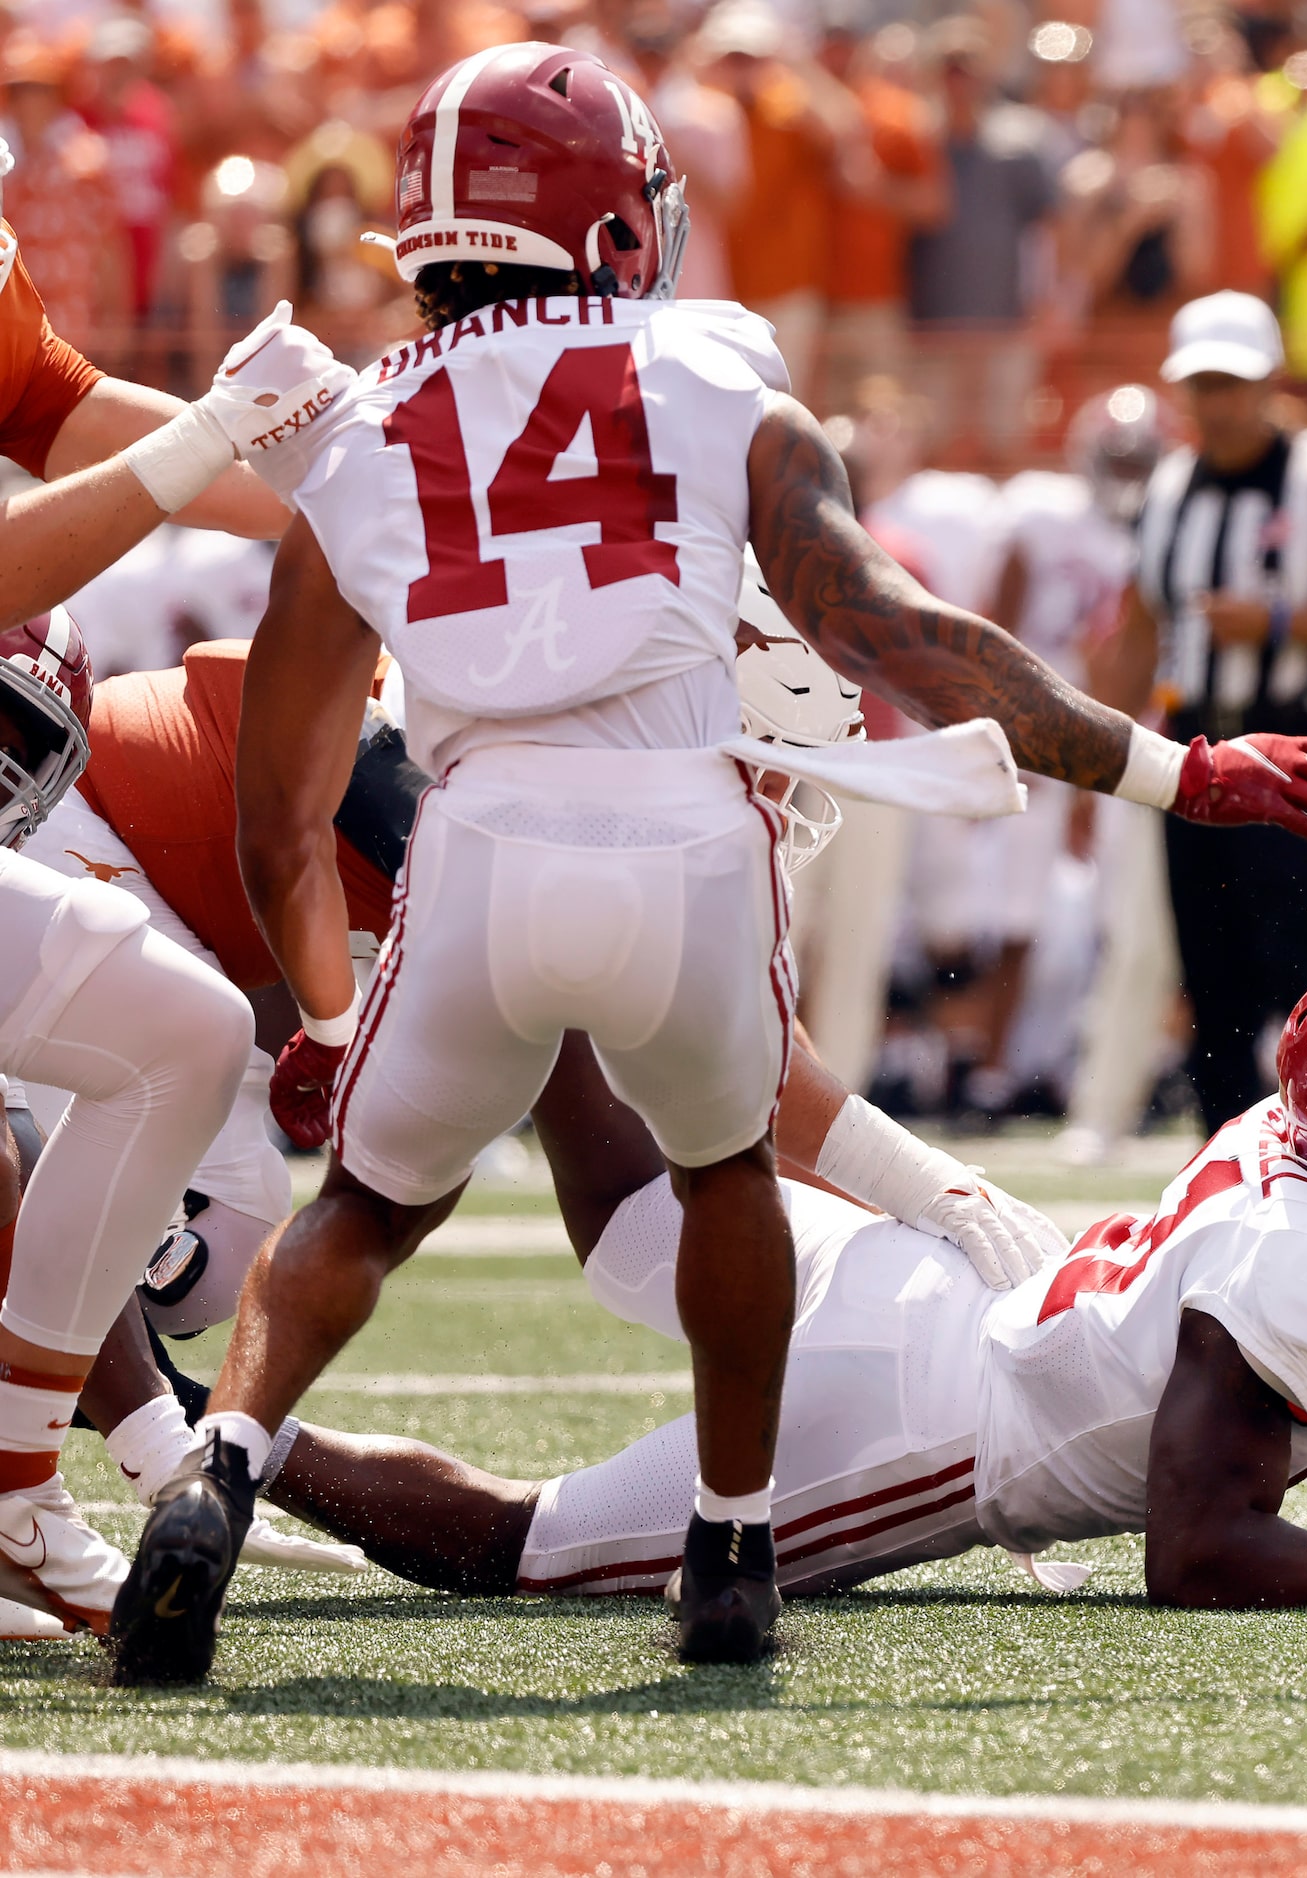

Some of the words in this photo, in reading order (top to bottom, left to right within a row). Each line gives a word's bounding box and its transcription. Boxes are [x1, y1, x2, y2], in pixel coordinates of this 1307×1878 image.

[603, 80, 656, 159] 14
[466, 231, 517, 251] TIDE
[251, 388, 333, 450] TEXAS
[382, 342, 680, 624] 14
[29, 663, 64, 698] BAMA
